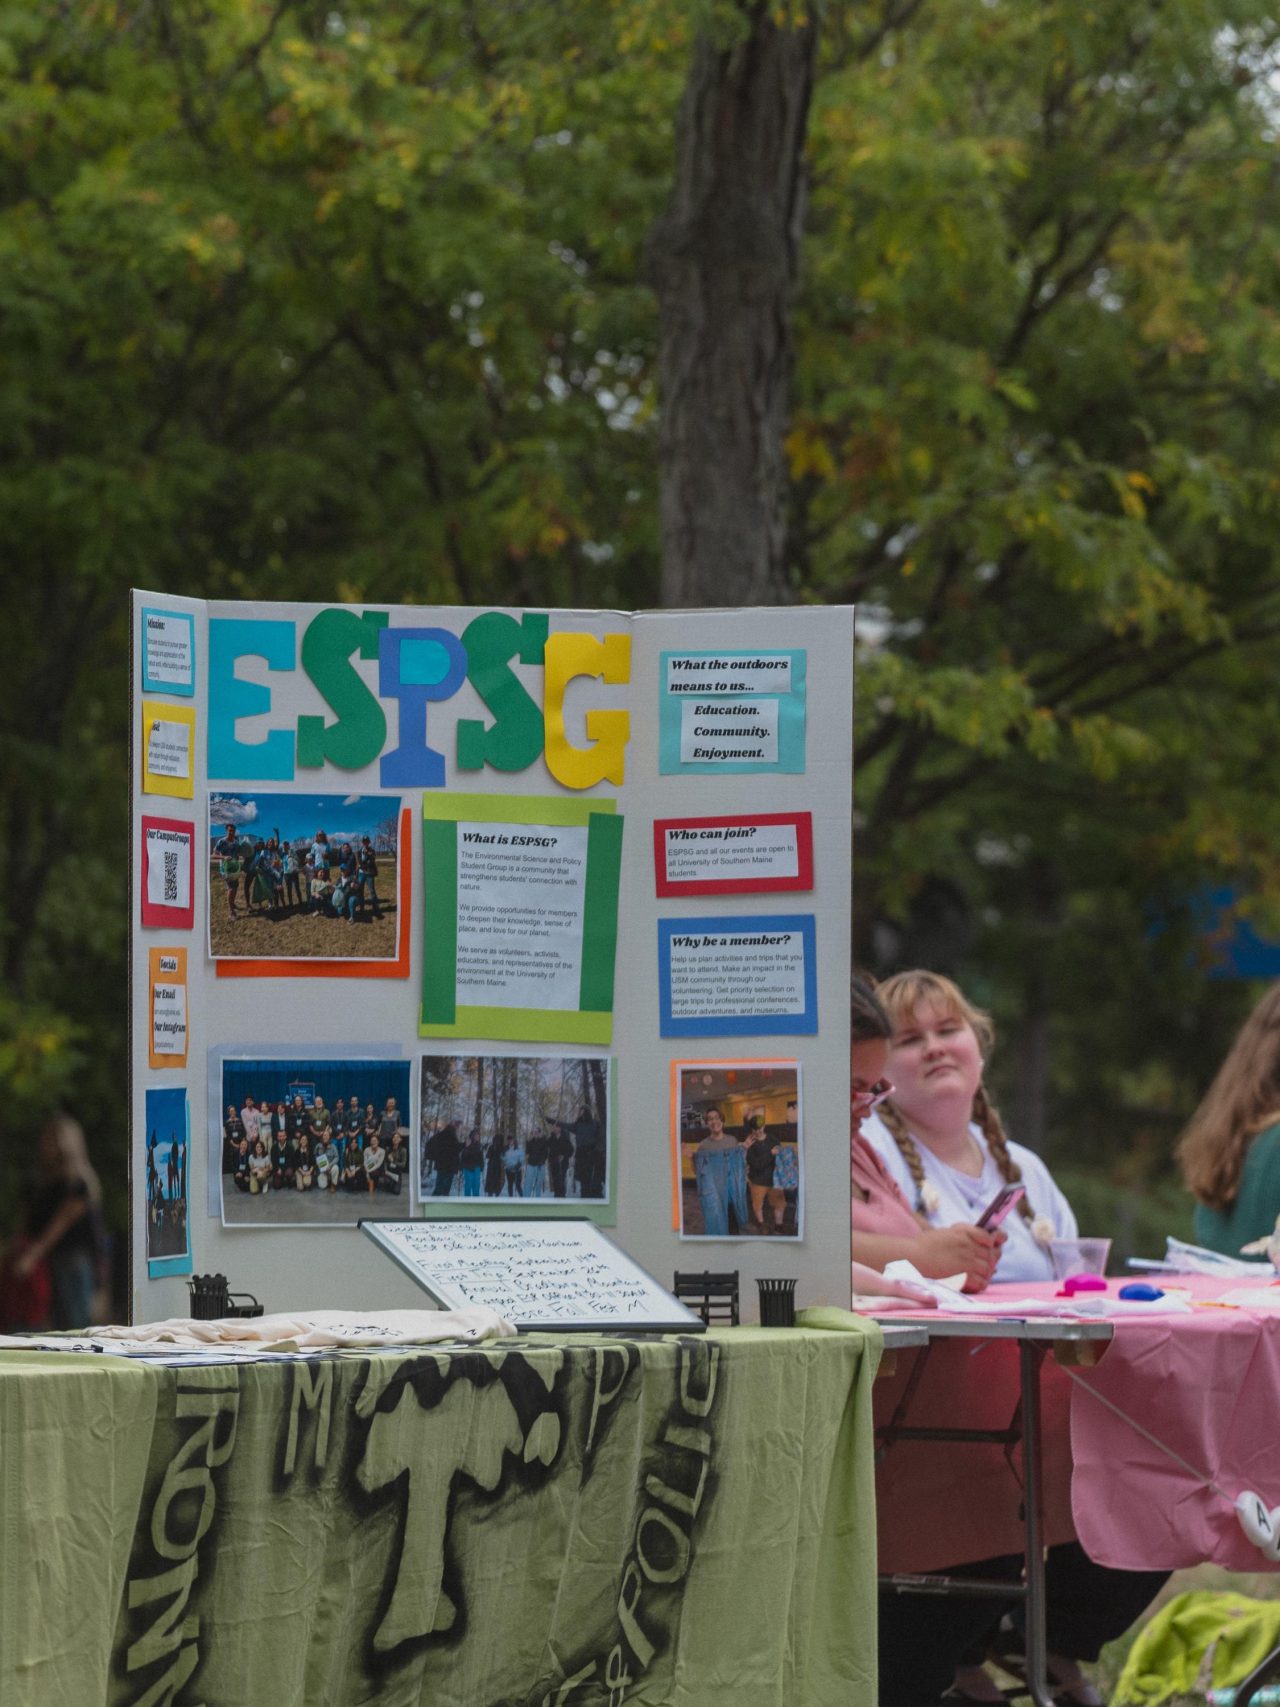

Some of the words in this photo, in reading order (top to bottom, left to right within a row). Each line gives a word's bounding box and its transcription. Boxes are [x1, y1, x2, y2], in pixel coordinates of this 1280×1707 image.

[672, 660, 706, 669] What
[708, 660, 728, 669] the
[730, 660, 788, 669] outdoors
[670, 683, 712, 691] means
[715, 682, 727, 690] to
[207, 608, 632, 789] ESPSG
[694, 705, 760, 715] Education.
[694, 727, 770, 738] Community.
[693, 748, 764, 759] Enjoyment.
[463, 833, 495, 844] What
[497, 834, 508, 845] is
[511, 836, 558, 847] ESPSG?
[669, 830, 698, 840] Who
[700, 831, 722, 839] can
[724, 828, 757, 840] join?
[475, 852, 521, 861] Environmental
[523, 855, 547, 863] Science
[563, 857, 581, 866] Policy
[461, 862, 485, 870] Student
[487, 864, 507, 873] Group
[521, 866, 555, 876] community
[460, 873, 497, 883] strengthens
[499, 875, 528, 883] students'
[529, 877, 563, 885] connection
[472, 905, 495, 914] provide
[497, 906, 536, 916] opportunities
[548, 909, 577, 917] members
[467, 915, 490, 924] deepen
[508, 917, 541, 927] knowledge,
[459, 926, 477, 934] place,
[530, 930, 550, 938] planet.
[673, 937, 701, 948] Why
[703, 936, 717, 946] be
[730, 935, 791, 946] member?
[498, 948, 531, 957] volunteers,
[534, 950, 560, 958] activists,
[458, 957, 489, 965] educators,
[506, 960, 553, 970] representatives
[457, 967, 495, 975] environment
[517, 970, 547, 979] University
[730, 986, 752, 994] priority
